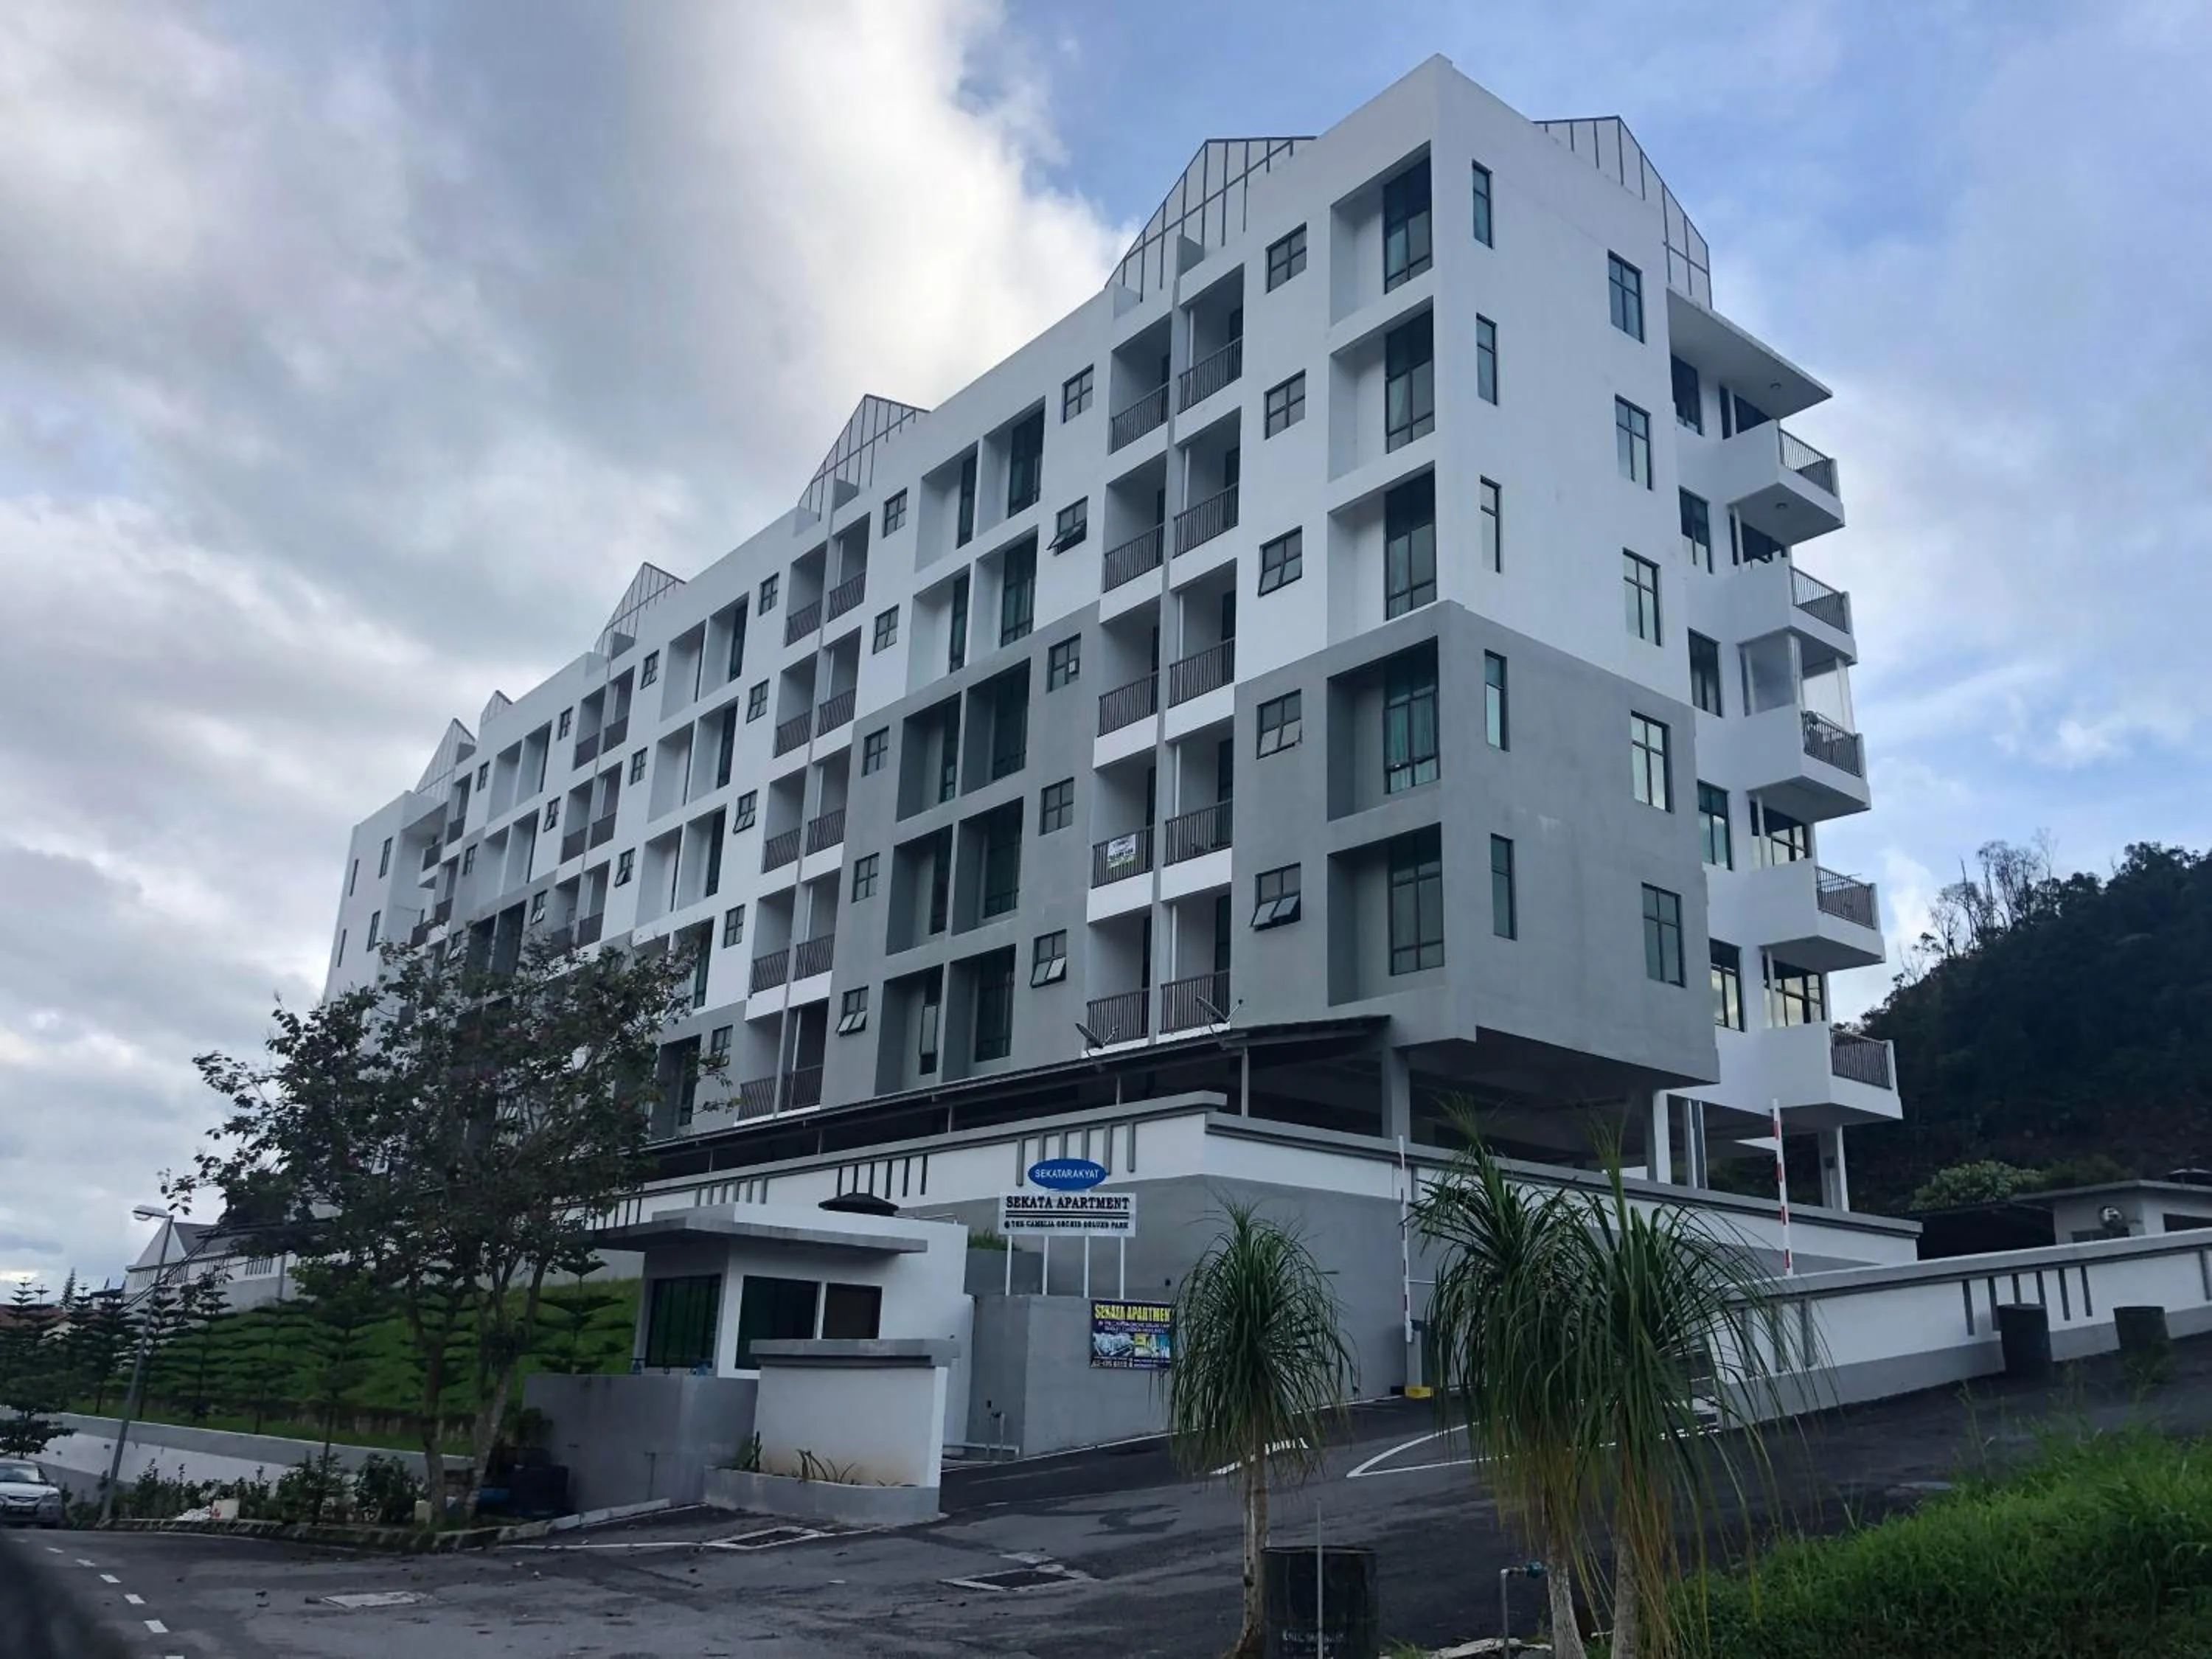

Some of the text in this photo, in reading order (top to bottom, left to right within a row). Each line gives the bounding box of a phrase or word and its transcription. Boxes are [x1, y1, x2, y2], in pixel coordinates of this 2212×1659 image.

[1034, 1169, 1099, 1179] SEKATARAKYAT
[1006, 1195, 1130, 1210] SEKATA APARTMENT
